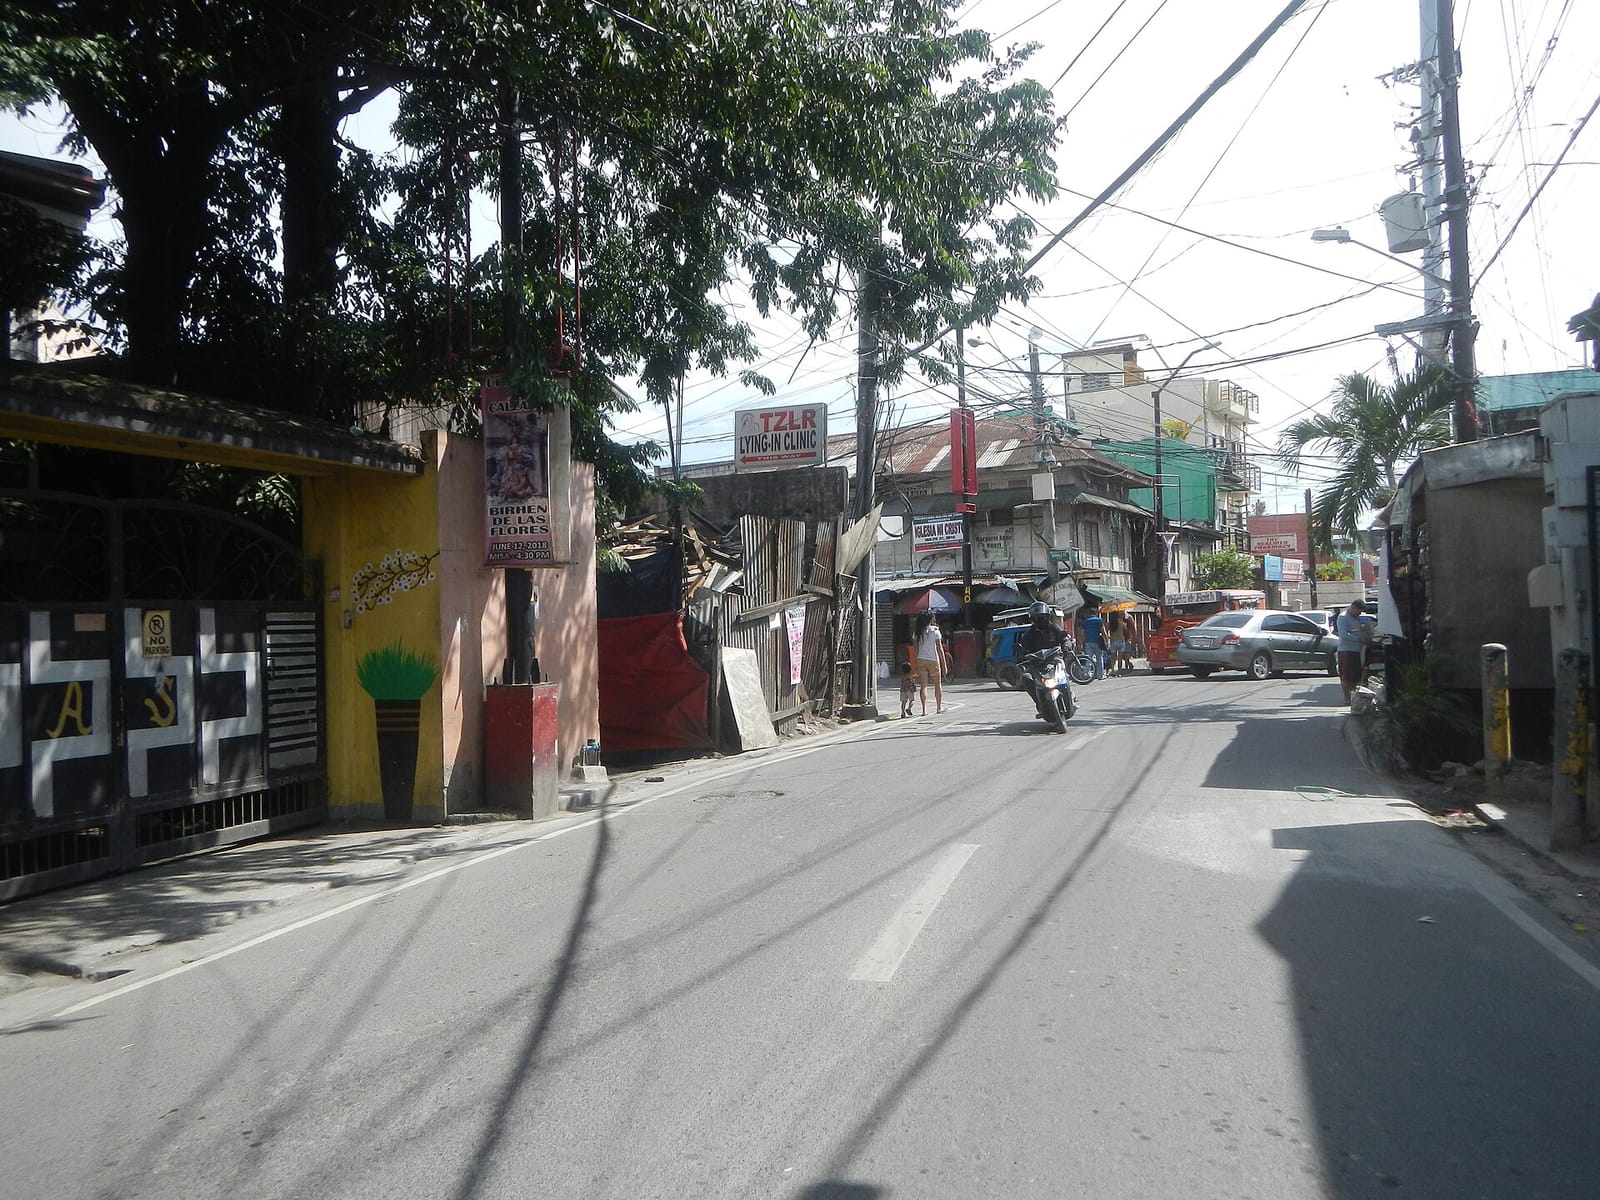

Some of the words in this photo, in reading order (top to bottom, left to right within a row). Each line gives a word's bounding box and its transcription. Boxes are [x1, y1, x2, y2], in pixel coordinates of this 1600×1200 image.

[489, 401, 528, 413] CALZA
[760, 409, 816, 432] TZLR
[740, 433, 780, 454] LYING-IN
[784, 430, 816, 450] CLINIC
[490, 505, 547, 516] BIRHEN
[493, 516, 511, 525] DE
[517, 514, 546, 525] LAS
[491, 526, 549, 536] FLORES
[914, 524, 937, 538] IGLESIA
[936, 523, 944, 536] NI
[944, 521, 964, 536] CRIST
[492, 542, 512, 551] JUNE
[513, 542, 527, 552] 12,
[528, 541, 548, 550] 2018
[488, 552, 510, 561] MISA
[516, 551, 535, 560] 4:30
[535, 551, 550, 560] PM
[149, 636, 166, 645] NO
[144, 645, 171, 655] PARKING
[46, 681, 92, 738] A
